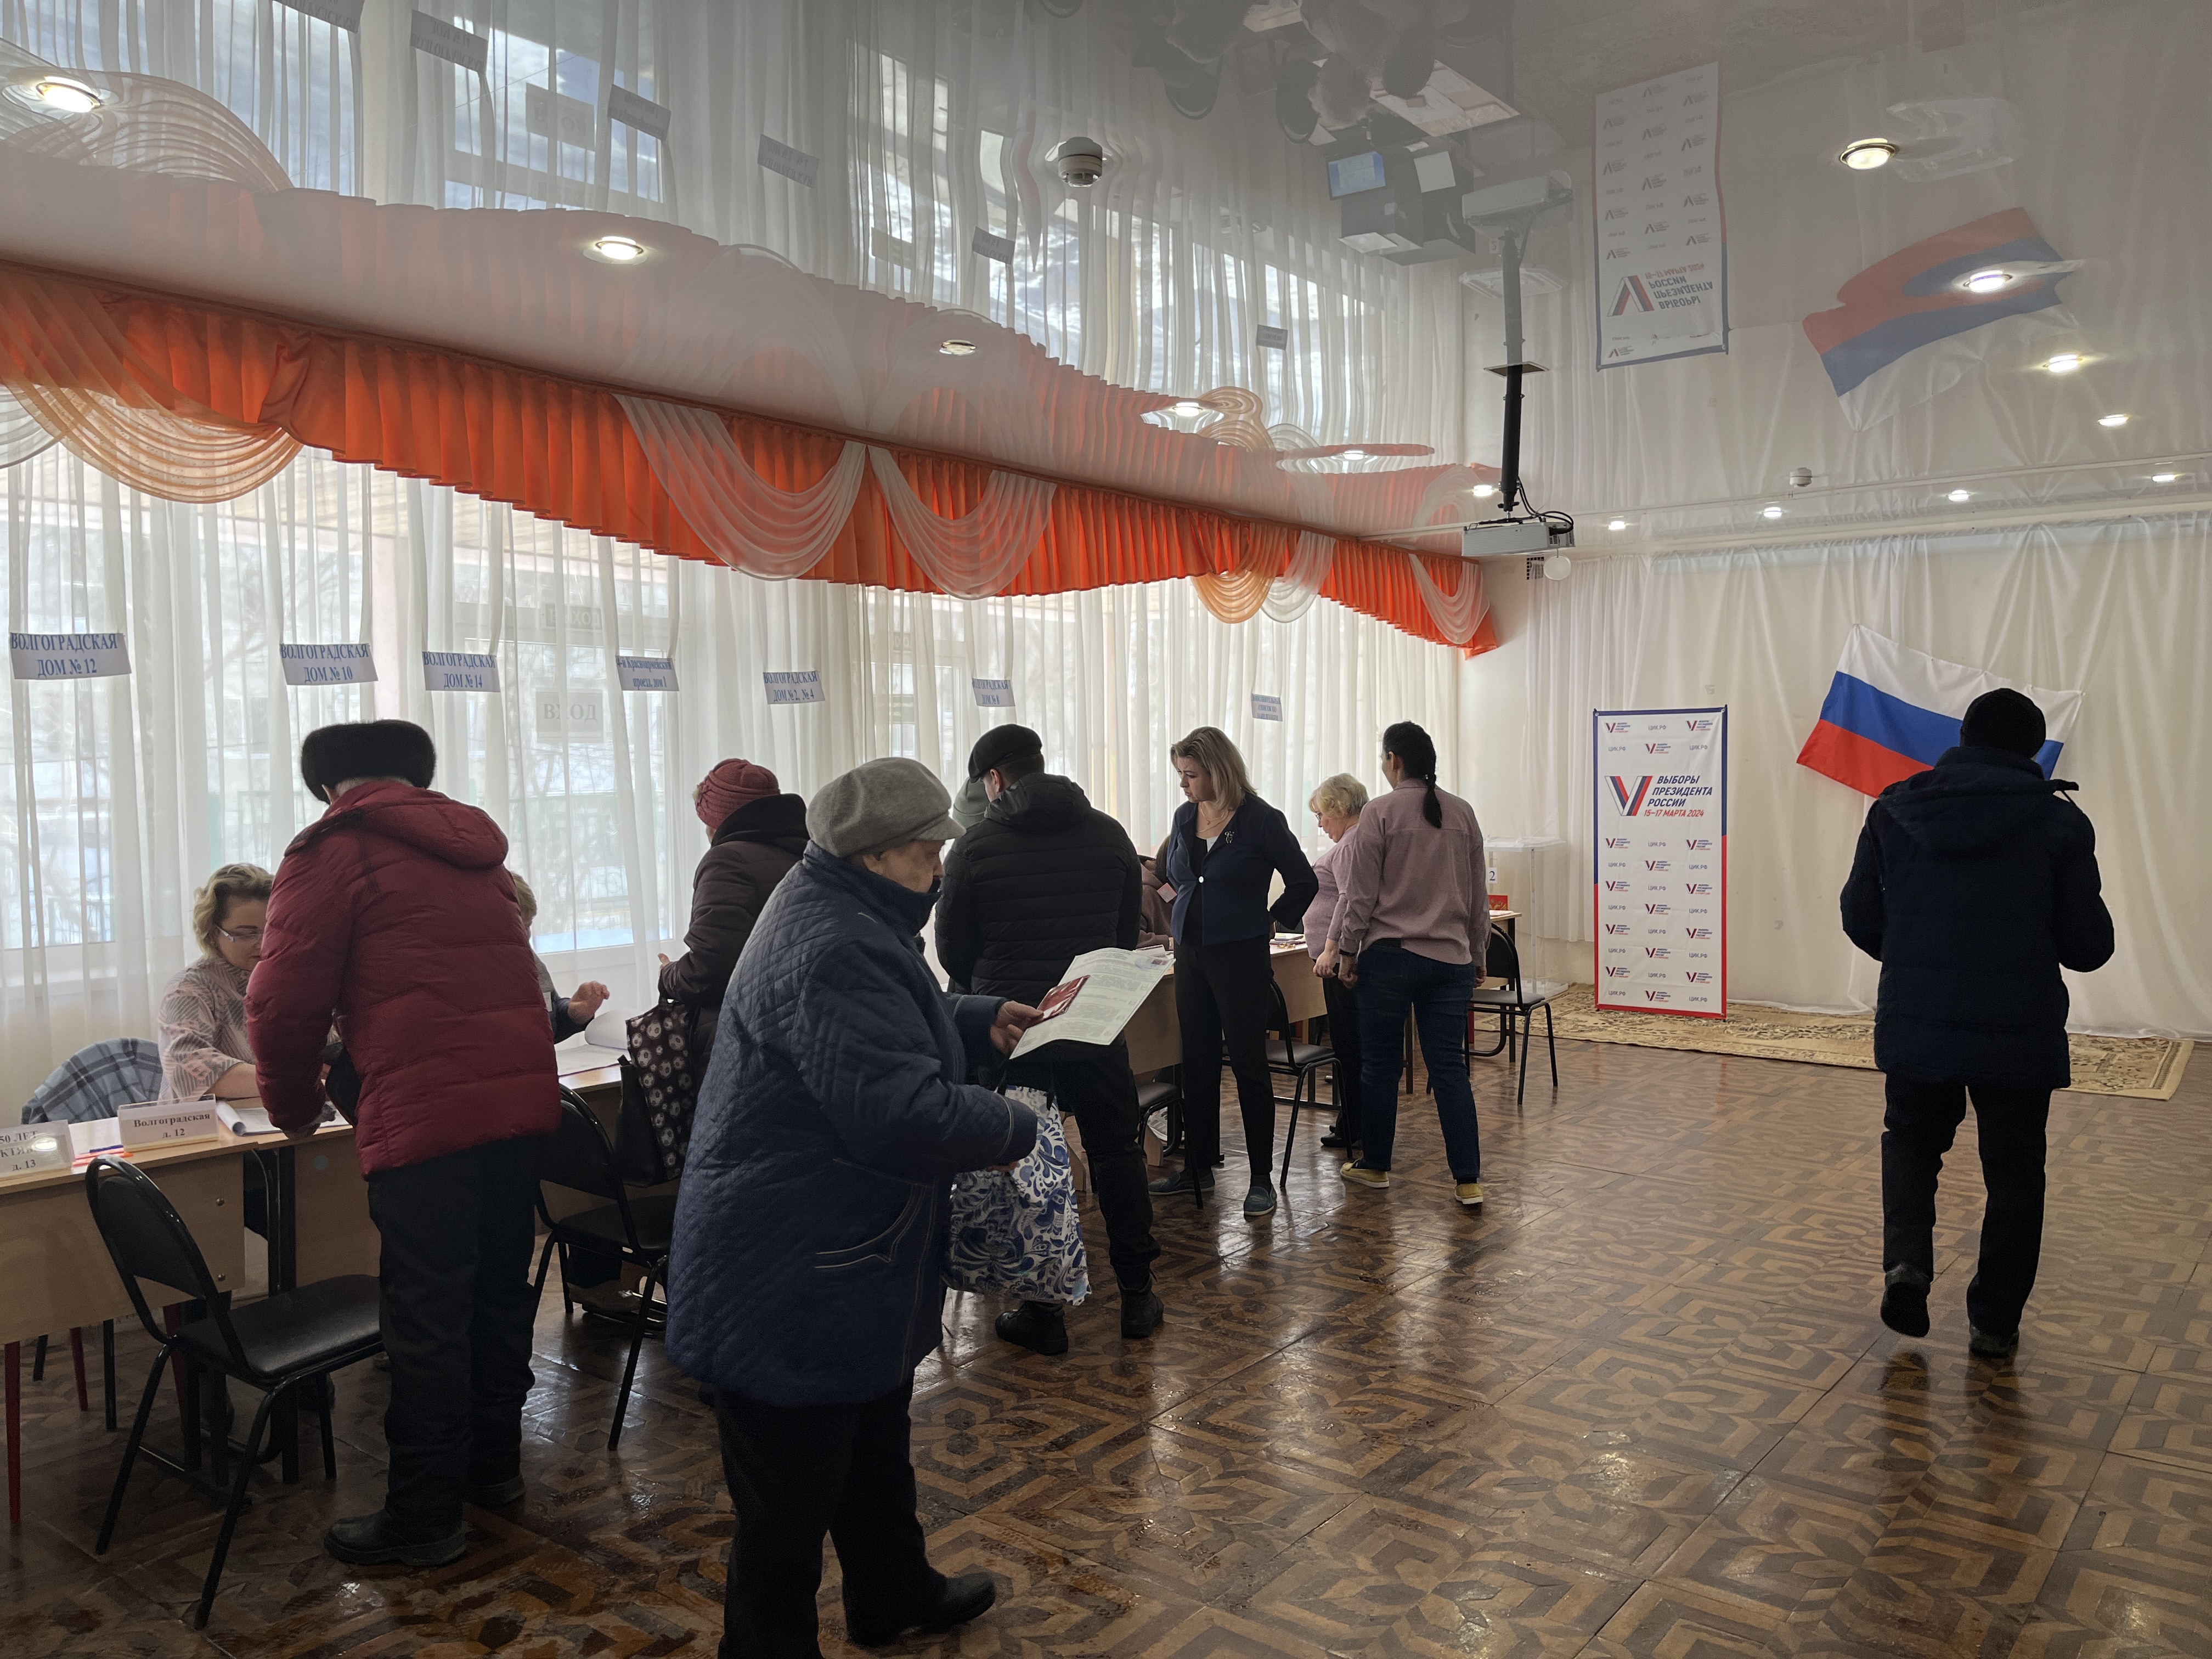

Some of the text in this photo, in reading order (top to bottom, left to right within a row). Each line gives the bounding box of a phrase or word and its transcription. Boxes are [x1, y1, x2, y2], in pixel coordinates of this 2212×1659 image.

[10, 633, 118, 651] ВОЛГОГРАДСКАЯ
[280, 644, 370, 660] ВОЛГОГРАДСКАЯ
[423, 652, 496, 669] ВОЛГОГРАДСКАЯ
[37, 660, 66, 678] ДОМ
[84, 658, 98, 674] 12
[303, 667, 326, 683] ДОМ
[342, 665, 353, 680] 10
[444, 673, 463, 689] ДОМ
[475, 675, 483, 689] 14
[653, 679, 663, 688] дом
[663, 675, 667, 687] 1
[764, 670, 819, 685] ВОЛГОГРАДСКАЯ
[773, 690, 788, 702] ДОМ
[810, 688, 815, 699] 4
[1657, 775, 1701, 784] ВЫБОРЫ
[1652, 787, 1713, 797] ПРЕЗИДЕНТА
[1647, 798, 1686, 807] РОССИИ
[1663, 809, 1686, 817] МАРТА
[1489, 871, 1496, 881] 2
[133, 1113, 211, 1128] Волгоградская
[162, 1128, 185, 1138] д. 12
[25, 1159, 36, 1169] 13
